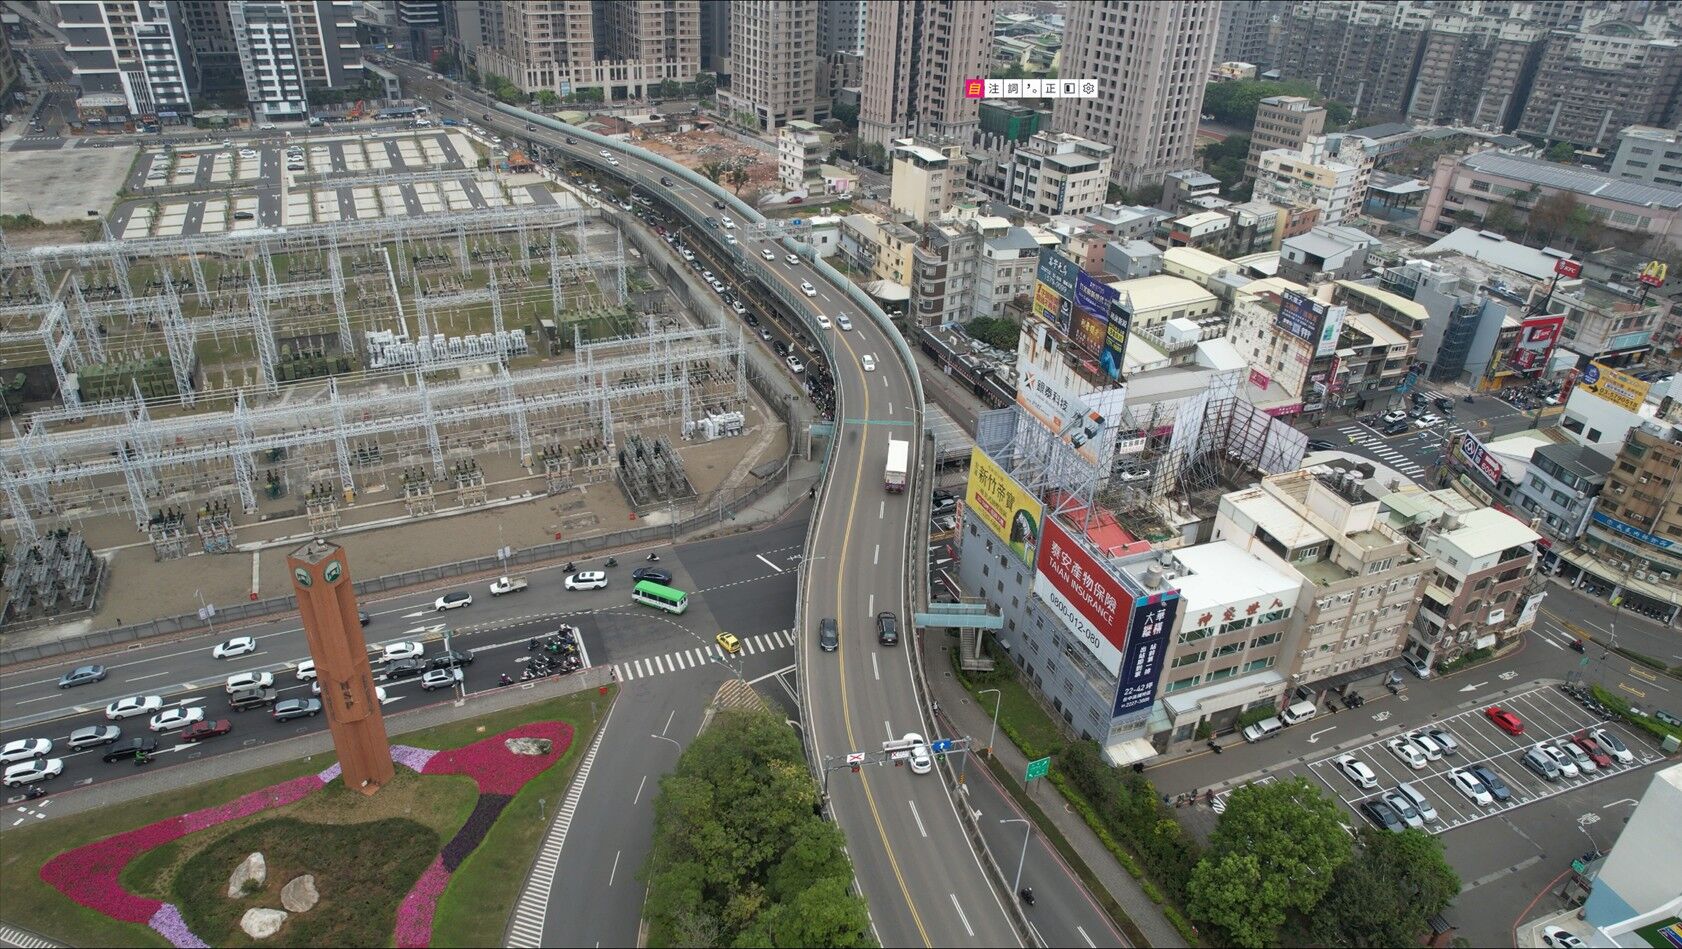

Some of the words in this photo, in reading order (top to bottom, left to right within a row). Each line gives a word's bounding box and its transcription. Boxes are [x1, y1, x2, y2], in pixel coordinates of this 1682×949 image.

[1563, 266, 1576, 274] KFC
[979, 466, 1016, 512] 新竹帝寶
[1048, 556, 1071, 583] TAIAN
[1070, 578, 1114, 627] INSURANCE
[1050, 540, 1117, 615] 泰安產物保險
[1050, 592, 1100, 649] 0800-012-080
